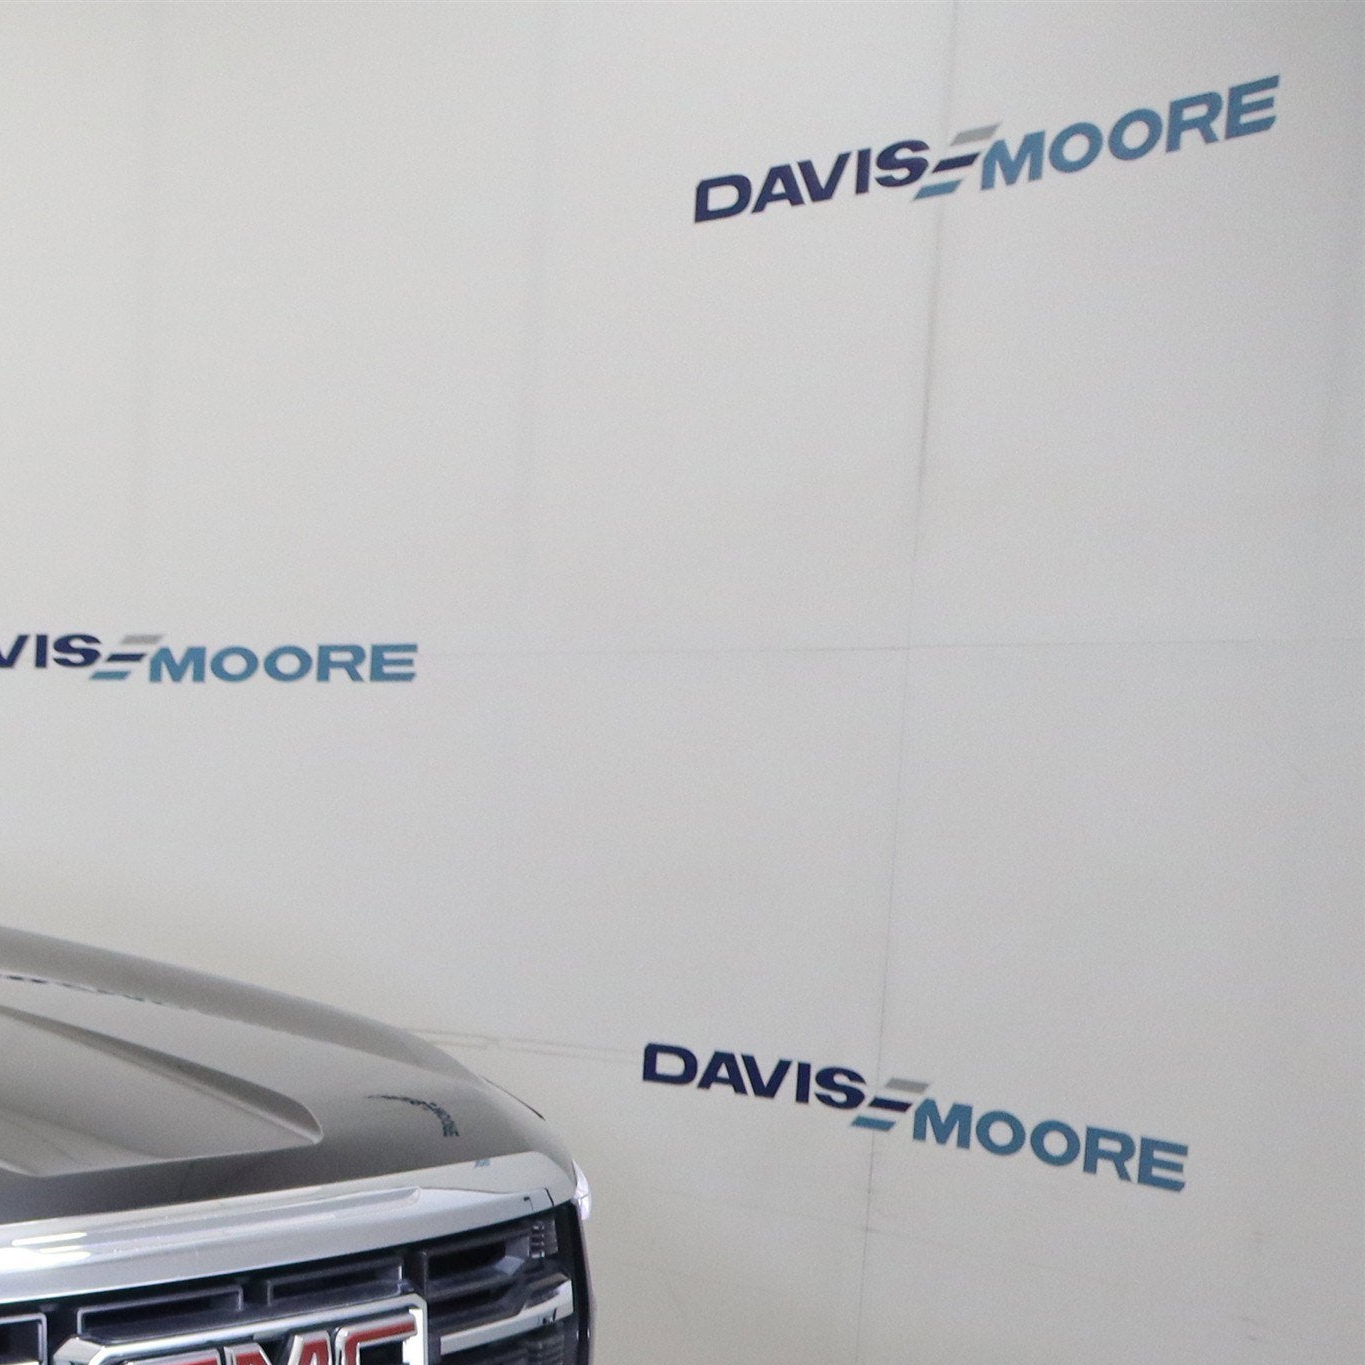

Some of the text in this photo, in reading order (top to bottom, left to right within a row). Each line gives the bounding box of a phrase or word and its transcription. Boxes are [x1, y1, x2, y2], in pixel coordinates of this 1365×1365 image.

[693, 74, 1280, 223] DAVIS MOORE
[149, 643, 419, 684] MOORE
[642, 1042, 1189, 1193] DAVIS MOORE
